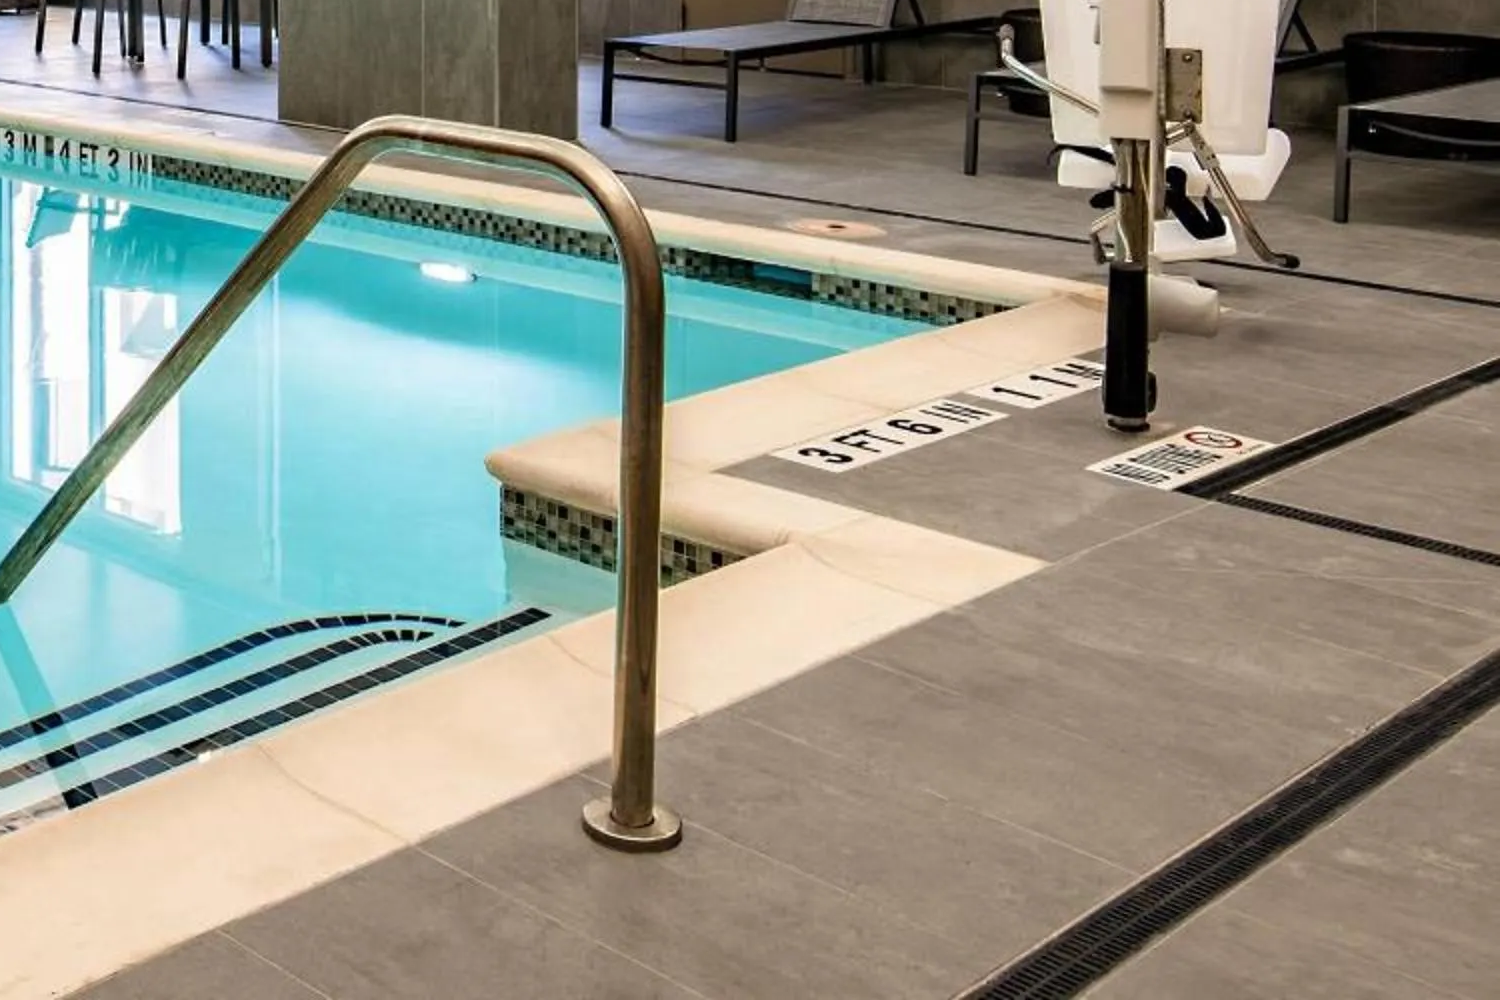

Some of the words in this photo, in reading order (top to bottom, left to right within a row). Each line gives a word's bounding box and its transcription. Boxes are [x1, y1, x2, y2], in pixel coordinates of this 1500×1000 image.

[798, 447, 853, 465] 3
[832, 429, 905, 453] FT
[887, 419, 943, 436] 6
[920, 403, 993, 424] IN
